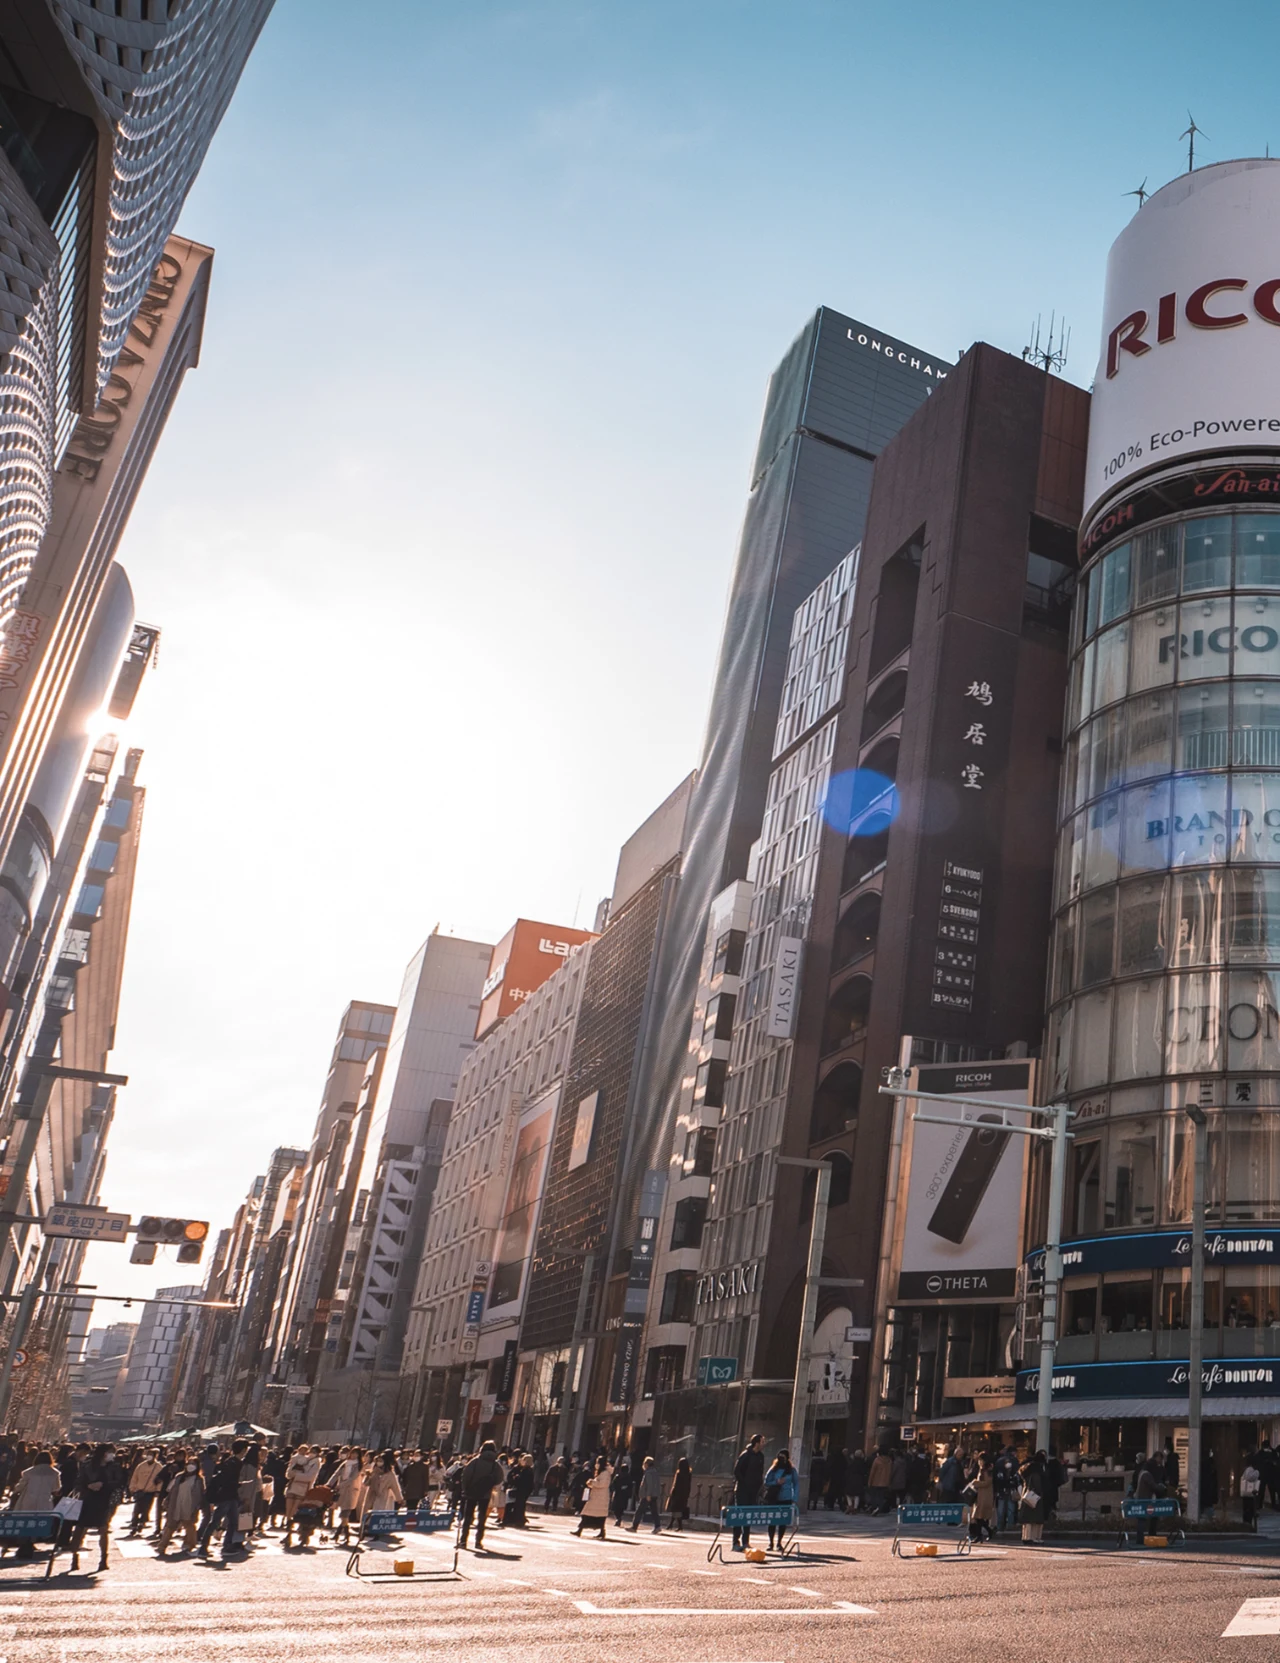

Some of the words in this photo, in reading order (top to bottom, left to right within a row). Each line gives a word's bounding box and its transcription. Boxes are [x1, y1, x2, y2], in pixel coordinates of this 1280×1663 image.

[847, 328, 948, 379] LONGCHAM
[1103, 441, 1143, 481] 100%
[961, 680, 993, 790] 鳩居堂
[1146, 808, 1254, 840] BRAND
[775, 949, 797, 1026] TASAKI
[956, 1073, 992, 1082] RICOH
[51, 1214, 123, 1232] 銀座四丁目
[1062, 1251, 1083, 1264] UTOR
[1172, 1237, 1190, 1254] Le
[1227, 1239, 1274, 1252] DOUTOR
[697, 1265, 758, 1305] TASAKI
[944, 1276, 988, 1290] THETA
[1167, 1366, 1187, 1383] Le
[1225, 1369, 1273, 1383] DOUTOR
